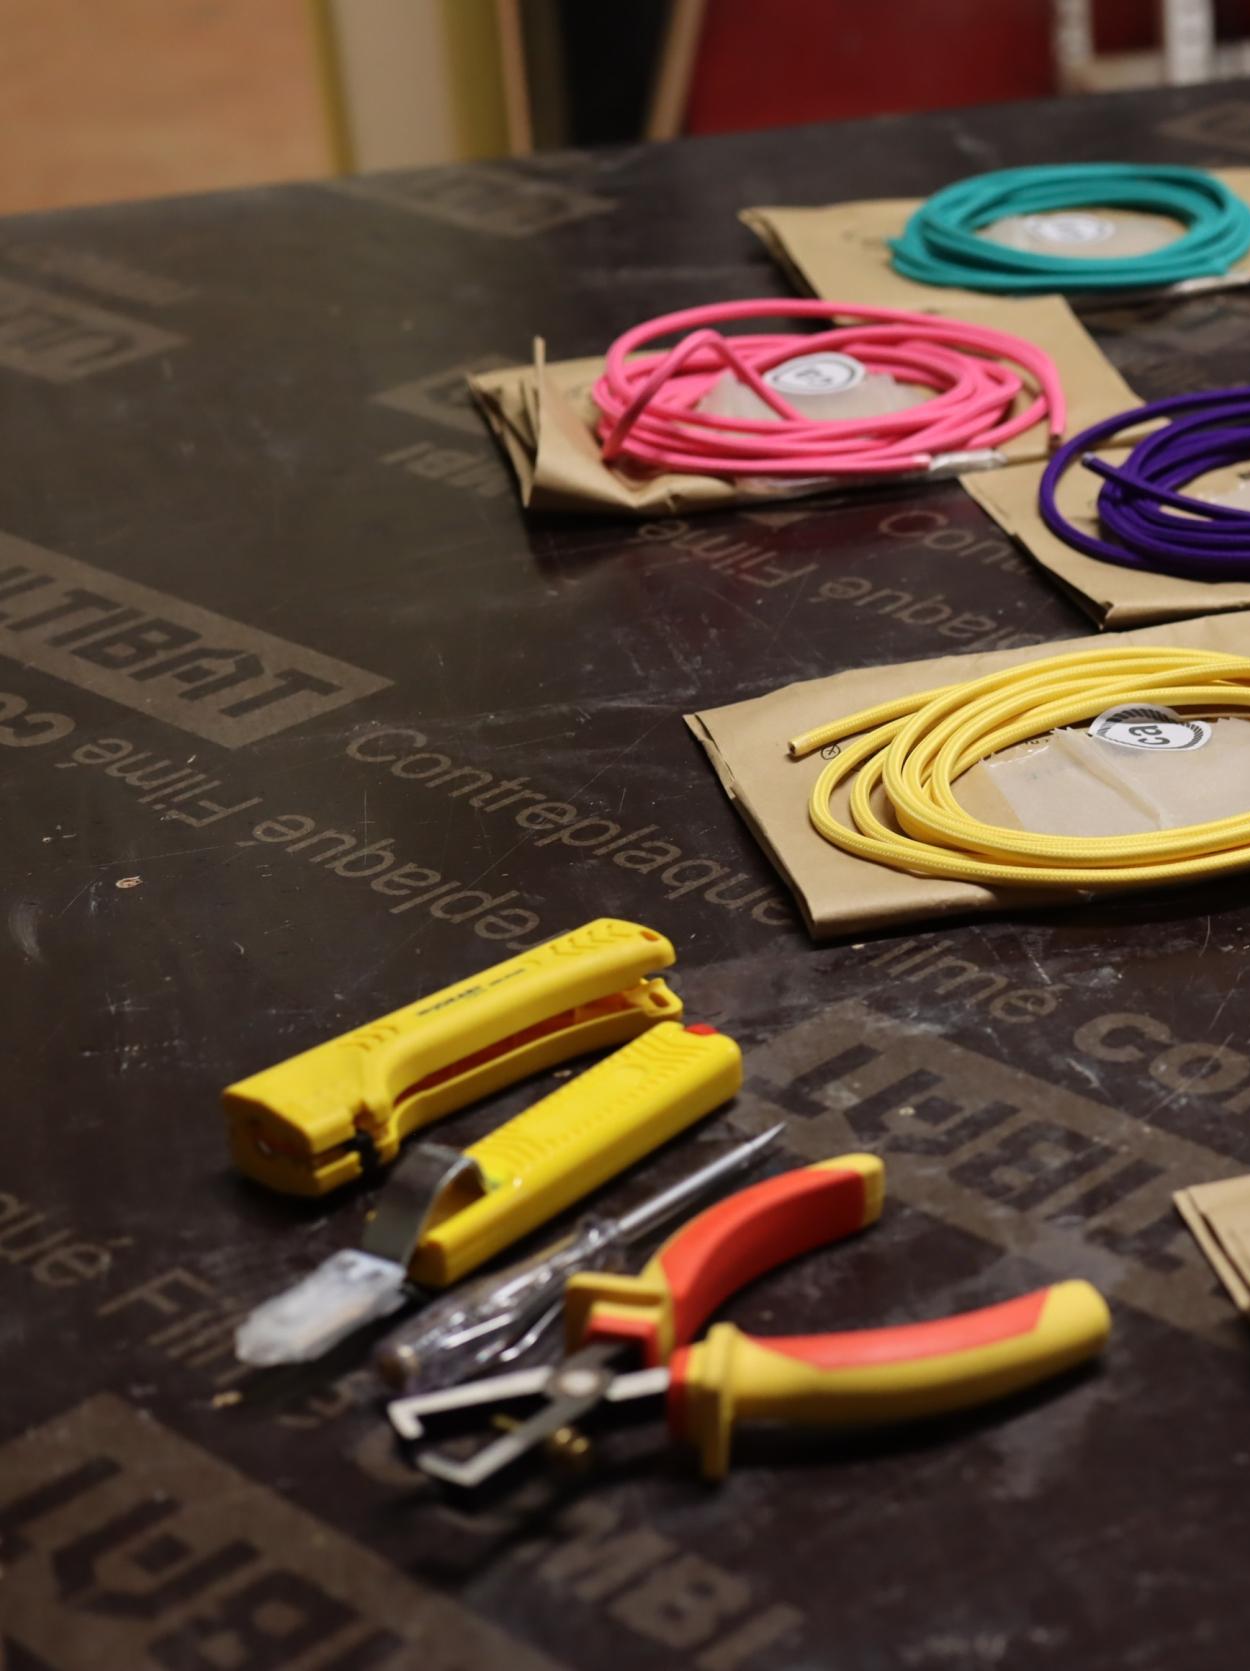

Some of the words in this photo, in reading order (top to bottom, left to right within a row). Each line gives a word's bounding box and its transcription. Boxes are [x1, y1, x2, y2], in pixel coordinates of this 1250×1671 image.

[0, 566, 344, 718] LTIBAT
[55, 737, 262, 829] Filmé
[235, 814, 570, 950] replaqué
[869, 932, 1073, 1024] ilmé
